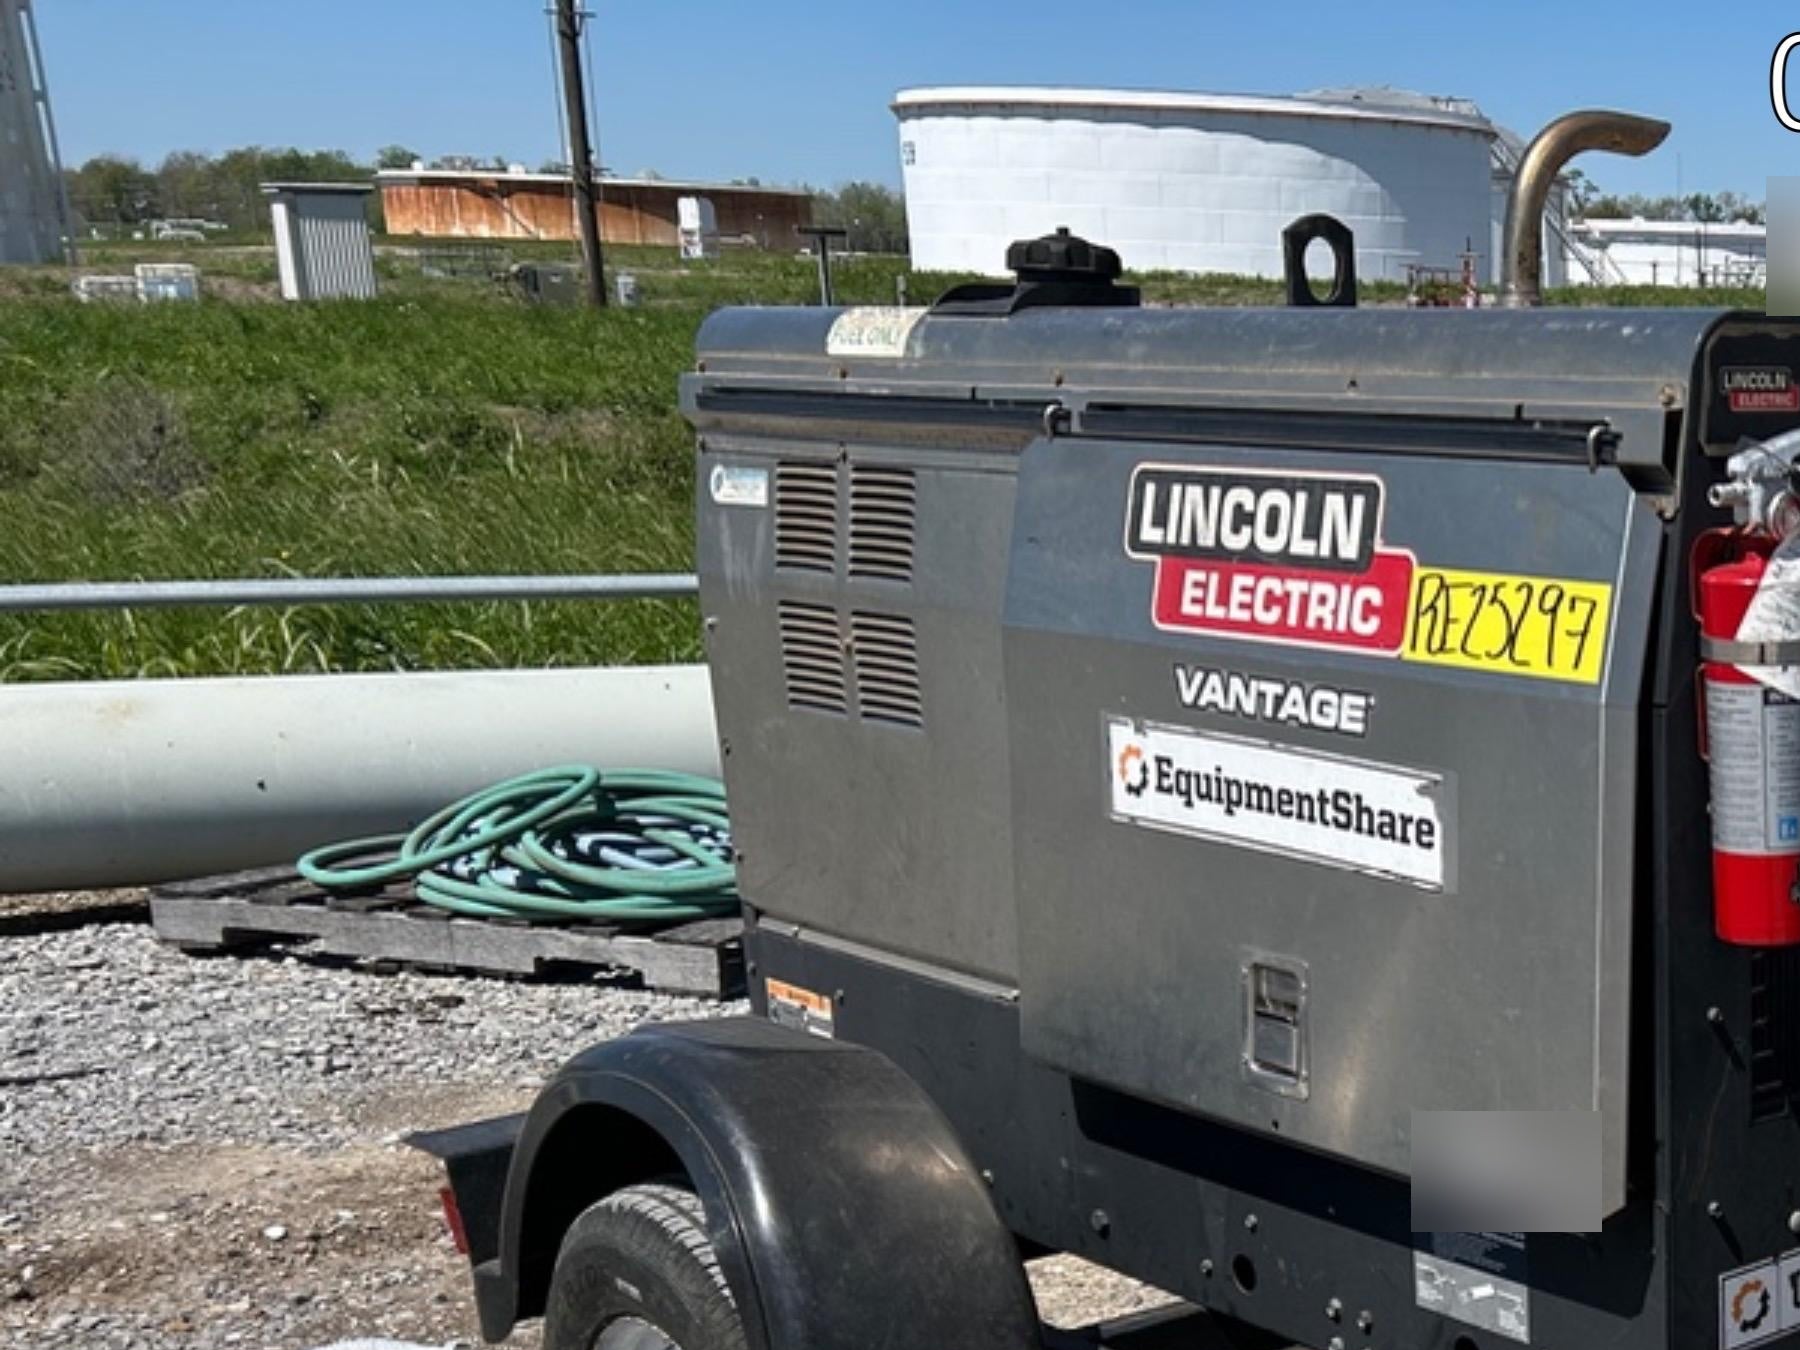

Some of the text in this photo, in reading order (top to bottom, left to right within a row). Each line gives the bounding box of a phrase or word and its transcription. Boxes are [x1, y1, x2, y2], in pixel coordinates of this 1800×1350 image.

[1724, 371, 1787, 391] LINCOLN
[1738, 391, 1795, 408] ELECTRIC
[1138, 480, 1367, 562] LINCOLN
[1179, 567, 1384, 637] ELECTRIC
[1410, 572, 1598, 671] RE25297
[1174, 665, 1370, 735] VANTAGE
[1153, 754, 1437, 850] EquipmentShare
